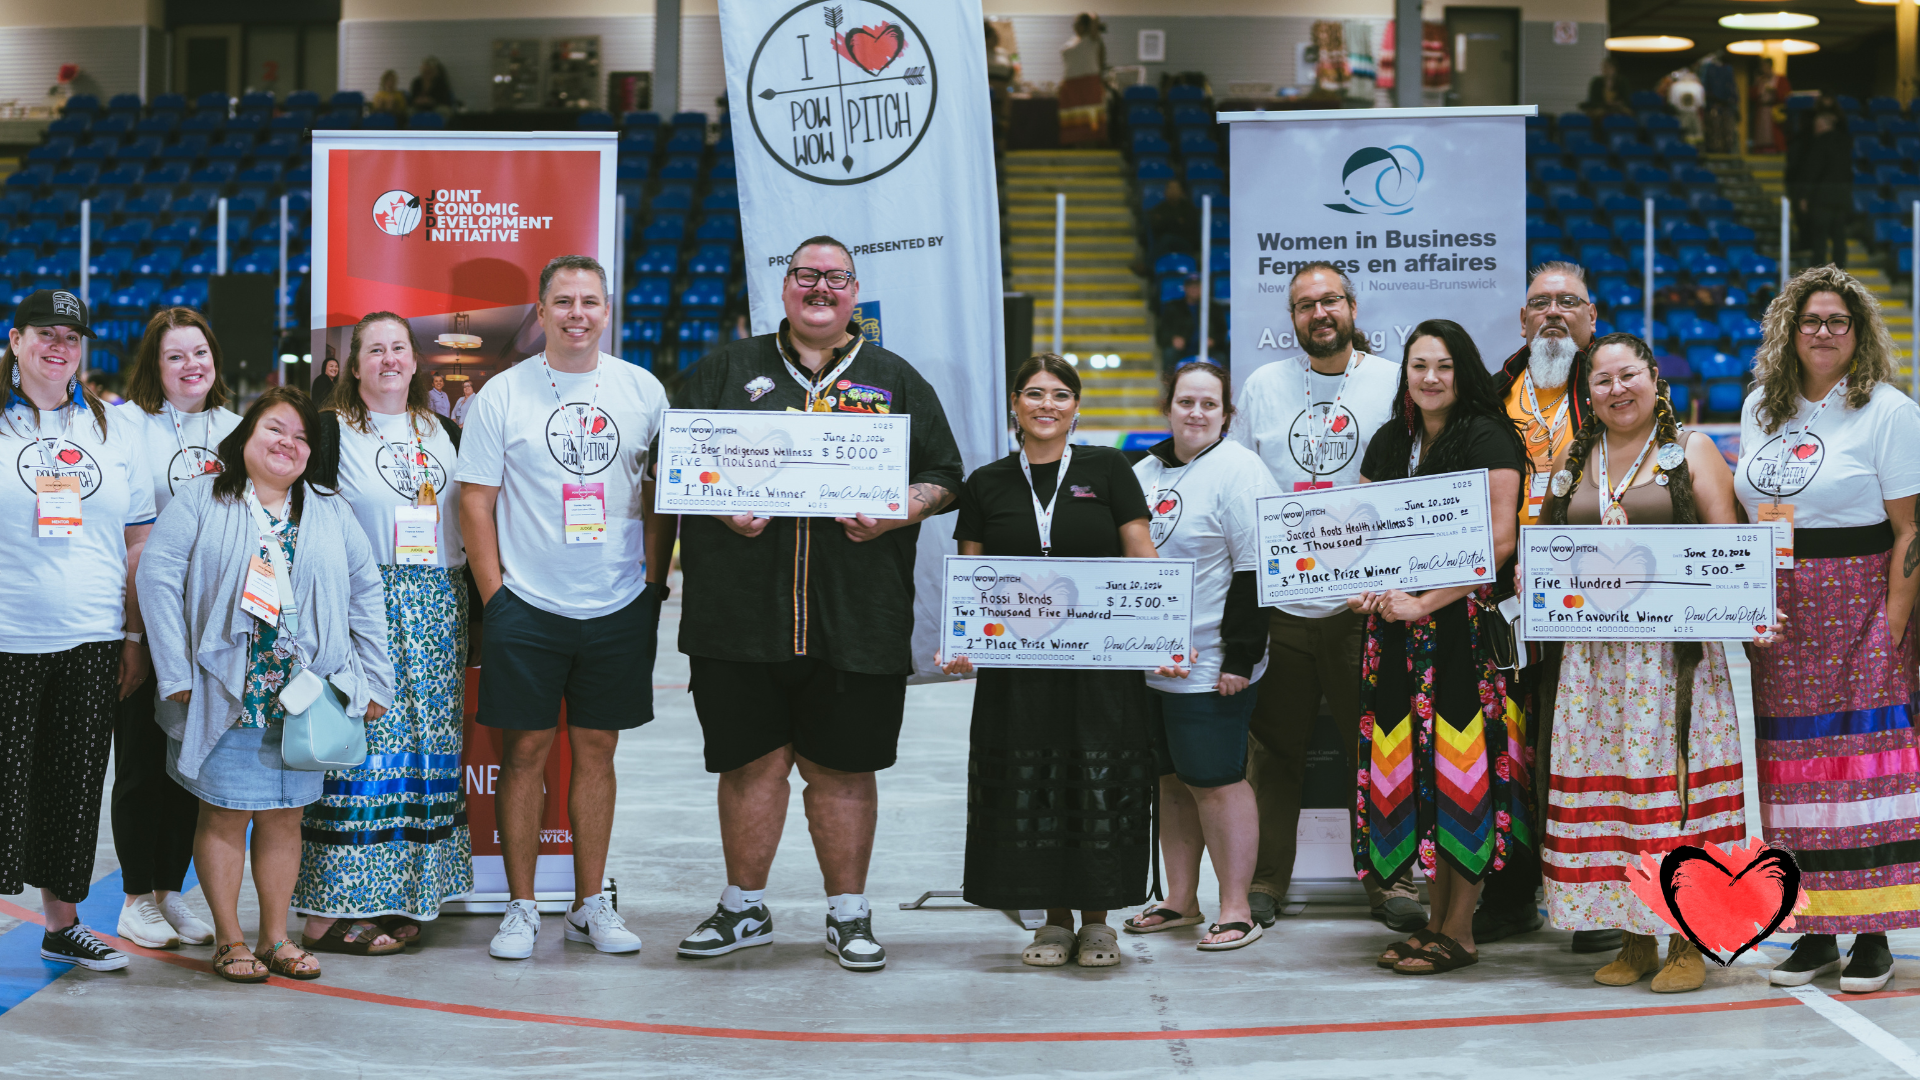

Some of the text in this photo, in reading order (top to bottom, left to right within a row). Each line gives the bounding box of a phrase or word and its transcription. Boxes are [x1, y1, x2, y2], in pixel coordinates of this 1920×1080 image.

[797, 34, 814, 81] I
[790, 96, 831, 131] POW
[847, 91, 912, 144] PITCH
[793, 131, 835, 167] WOW
[425, 189, 481, 202] JOINT
[425, 203, 520, 215] ECONOMIC
[425, 216, 553, 229] DEVELOPMENT
[425, 229, 519, 242] INITIATIVE
[1257, 229, 1497, 251] Women in Business
[849, 236, 944, 256] -PRESENTED BY
[1367, 258, 1397, 273] en
[1404, 253, 1497, 272] affaires
[1258, 282, 1285, 293] New
[1369, 278, 1497, 292] Nouveau-Brunswick
[823, 432, 846, 442] June
[584, 442, 609, 461] PITCH
[691, 443, 698, 454] 2
[701, 444, 720, 454] Bear
[725, 444, 769, 458] Indigenous
[773, 446, 812, 457] Wellness
[822, 447, 829, 457] $
[1324, 442, 1347, 460] PITCH
[671, 454, 777, 468] Five Thousand
[702, 485, 732, 496] Place
[737, 486, 760, 497] Prize
[765, 486, 806, 498] Winner
[1453, 481, 1472, 489] 1025
[1404, 500, 1424, 510] June
[1283, 511, 1303, 519] WOW
[1305, 509, 1326, 517] PITCH
[1407, 517, 1414, 527] $
[1287, 527, 1315, 541] Sacred
[1320, 525, 1342, 537] Roots
[1346, 522, 1370, 534] Health
[1376, 519, 1406, 531] Wellness
[1271, 535, 1362, 556] One Thousand
[1683, 547, 1706, 558] June
[1729, 549, 1751, 557] 2026
[1299, 572, 1330, 584] Place
[1334, 568, 1360, 580] Prize
[1364, 565, 1401, 578] Winner
[1685, 565, 1693, 575] $
[1105, 581, 1127, 590] June
[1535, 576, 1621, 589] Five Hundred
[981, 592, 1010, 604] Rossi
[1018, 592, 1052, 605] Blends
[1107, 596, 1114, 607] $
[953, 606, 1111, 619] Two Thousand Five Hundred
[1548, 610, 1673, 623] Fan Favourite Winner
[985, 639, 1017, 649] Place
[1021, 638, 1045, 649] Prize
[1050, 639, 1089, 650] Winner
